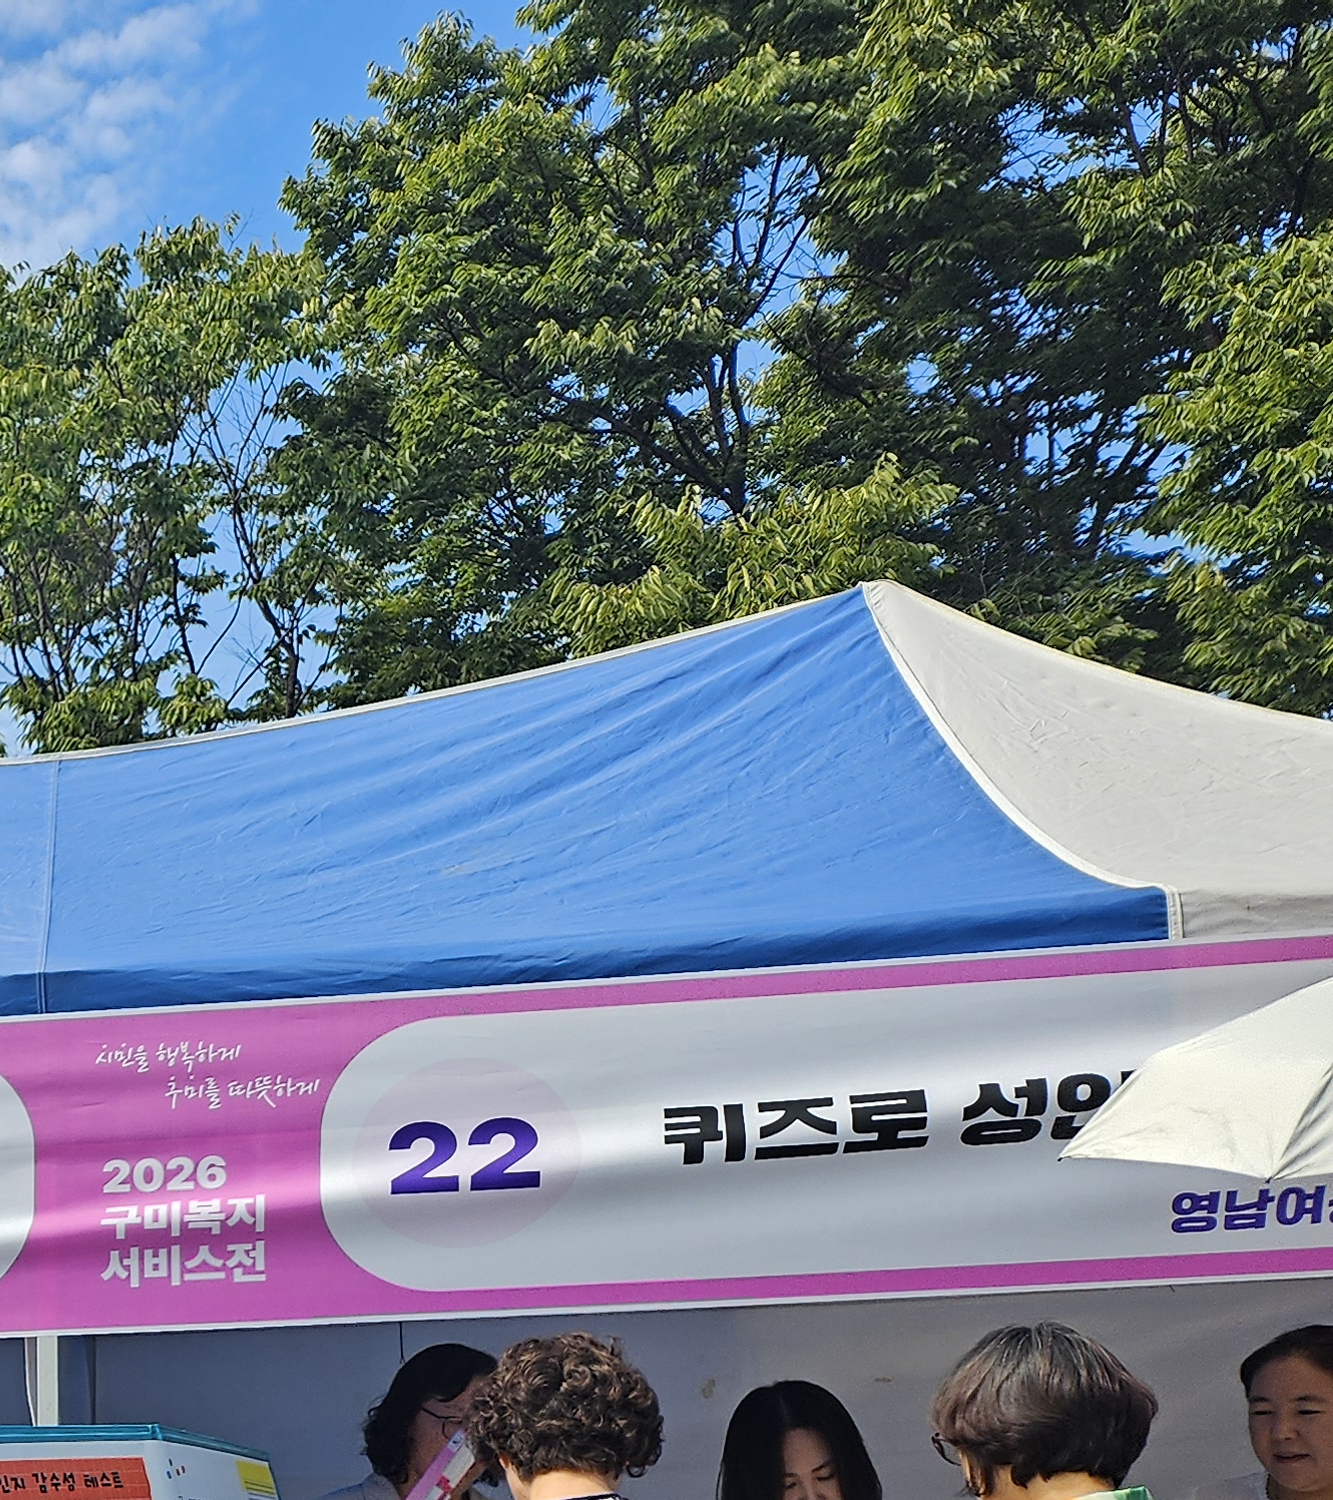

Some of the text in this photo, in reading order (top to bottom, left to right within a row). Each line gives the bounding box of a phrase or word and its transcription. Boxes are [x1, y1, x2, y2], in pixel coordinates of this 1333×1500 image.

[95, 1041, 241, 1074] 시민을 행복하게
[165, 1076, 320, 1110] 구미를 따뜻하게
[663, 1088, 930, 1166] 퀴즈로
[102, 1155, 226, 1195] 2026
[388, 1116, 541, 1195] 22
[100, 1195, 266, 1240] 구미복지
[1171, 1184, 1333, 1234] 영남여
[100, 1241, 267, 1288] 서비스전
[33, 1472, 76, 1494] 감수성
[83, 1471, 124, 1489] 테스트
